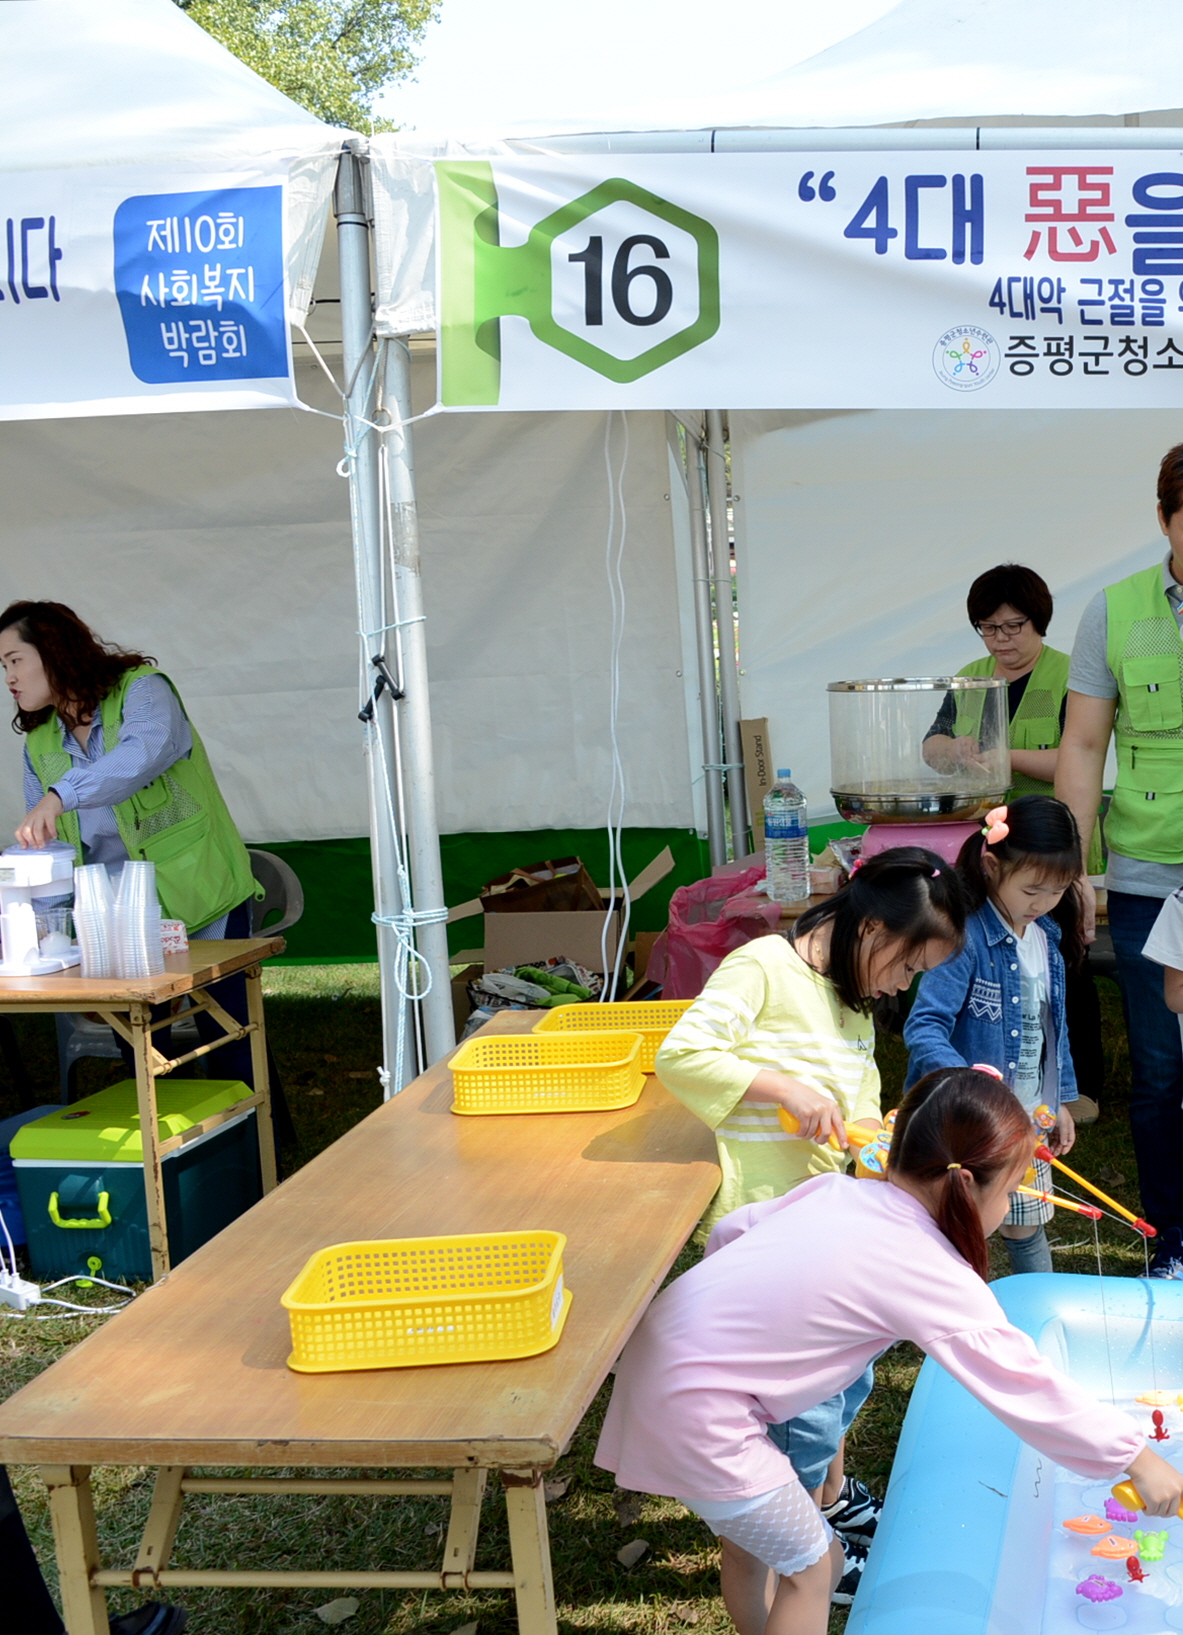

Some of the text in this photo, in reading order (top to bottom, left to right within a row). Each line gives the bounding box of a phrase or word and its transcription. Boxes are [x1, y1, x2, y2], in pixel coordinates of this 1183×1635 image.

[145, 212, 244, 252] 제10회
[797, 169, 984, 266] “4대
[140, 265, 256, 313] 사회복지
[567, 234, 673, 327] 16
[988, 276, 1066, 321] 4대악
[1077, 277, 1166, 328] 근절을
[161, 320, 248, 368] 박람회
[753, 734, 764, 758] Stand
